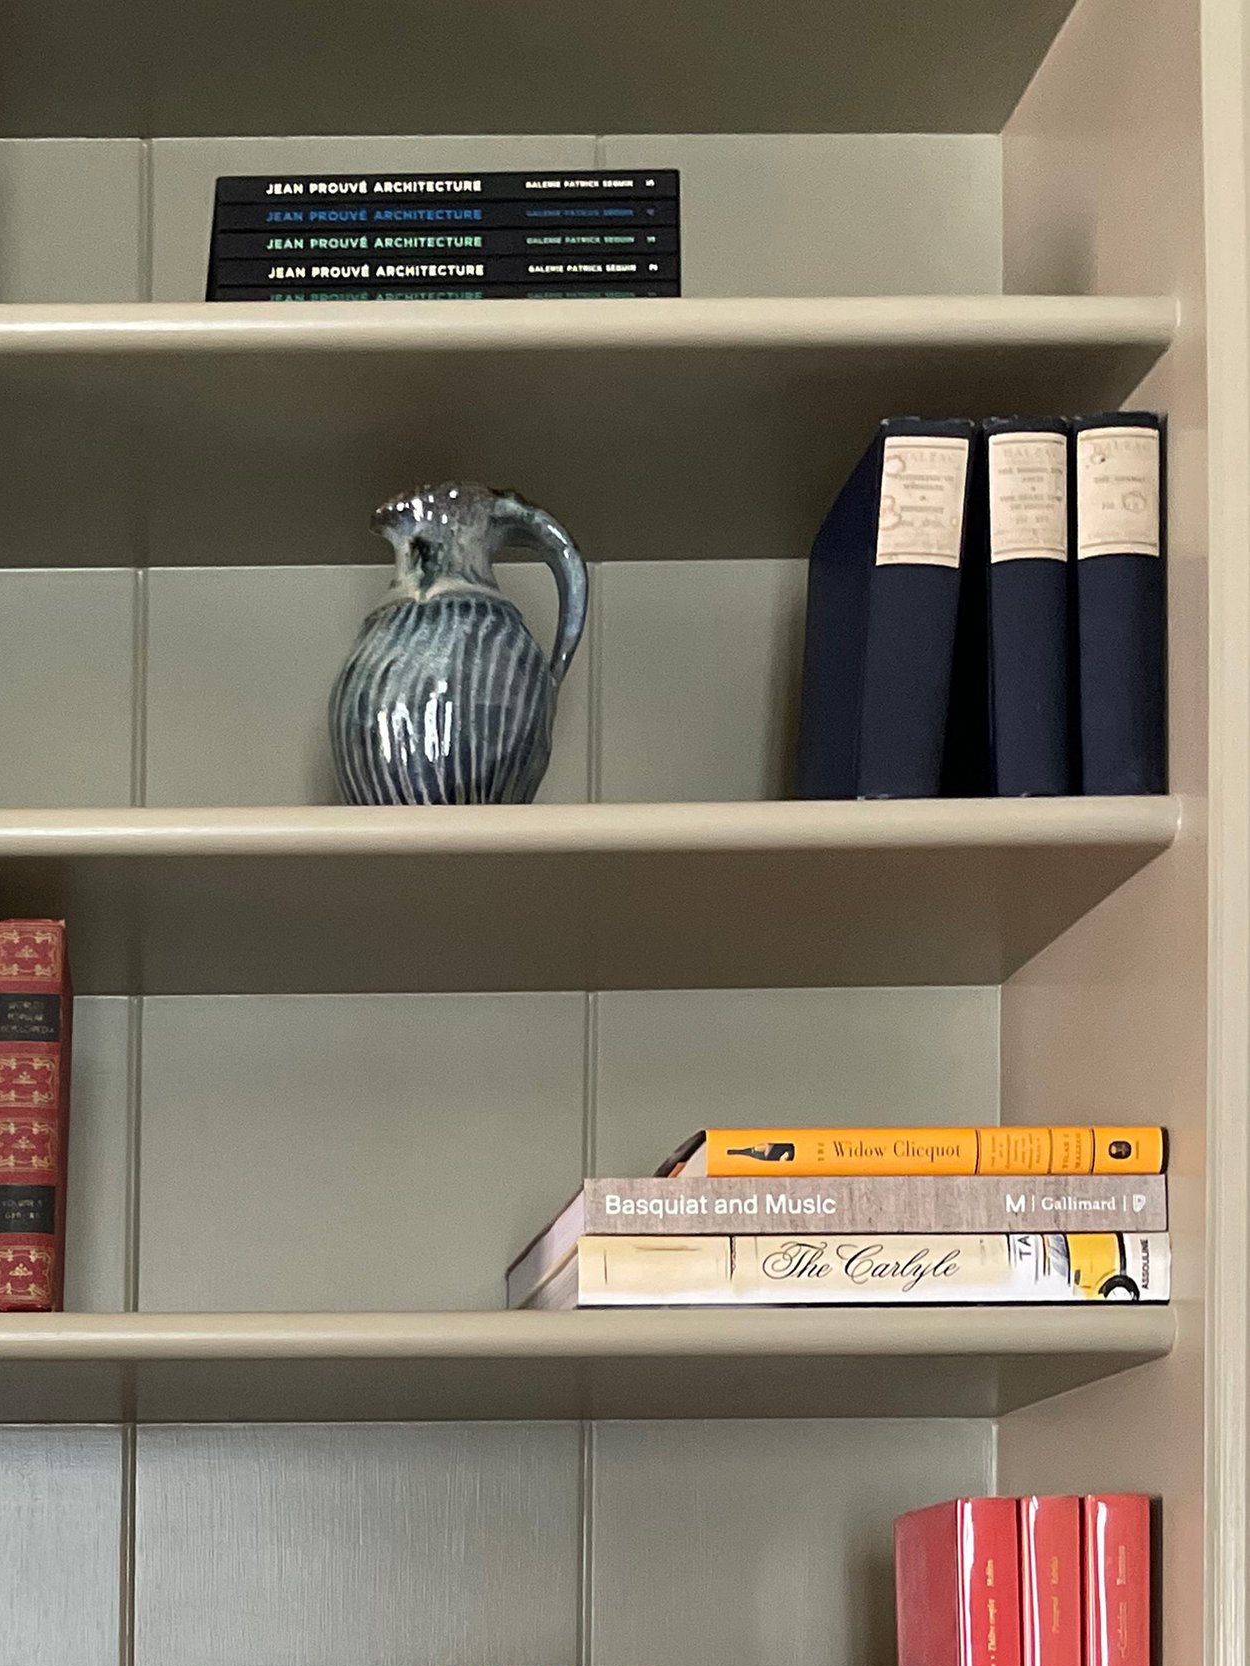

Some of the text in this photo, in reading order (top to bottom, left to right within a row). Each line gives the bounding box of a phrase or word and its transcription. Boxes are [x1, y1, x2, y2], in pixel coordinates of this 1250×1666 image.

[266, 183, 303, 195] JEAN
[309, 180, 368, 194] PROUVÉ
[374, 180, 482, 193] ARCHITECTURE
[266, 208, 482, 222] JEAN PROUVÉ ARCHITECTURE
[266, 236, 483, 250] JEAN PROUVÉ ARCHITECTURE
[268, 266, 305, 279] JEAN
[311, 264, 370, 278] PROUVÉ
[376, 264, 485, 277] ARCHITECTURE
[833, 1140, 887, 1158] Widow
[893, 1140, 962, 1163] Clicquot
[604, 1193, 837, 1220] Basquiat and Music
[1005, 1194, 1117, 1213] M Gallimard
[762, 1239, 962, 1291] The Carlyle
[1139, 1237, 1151, 1290] ASSOULINE
